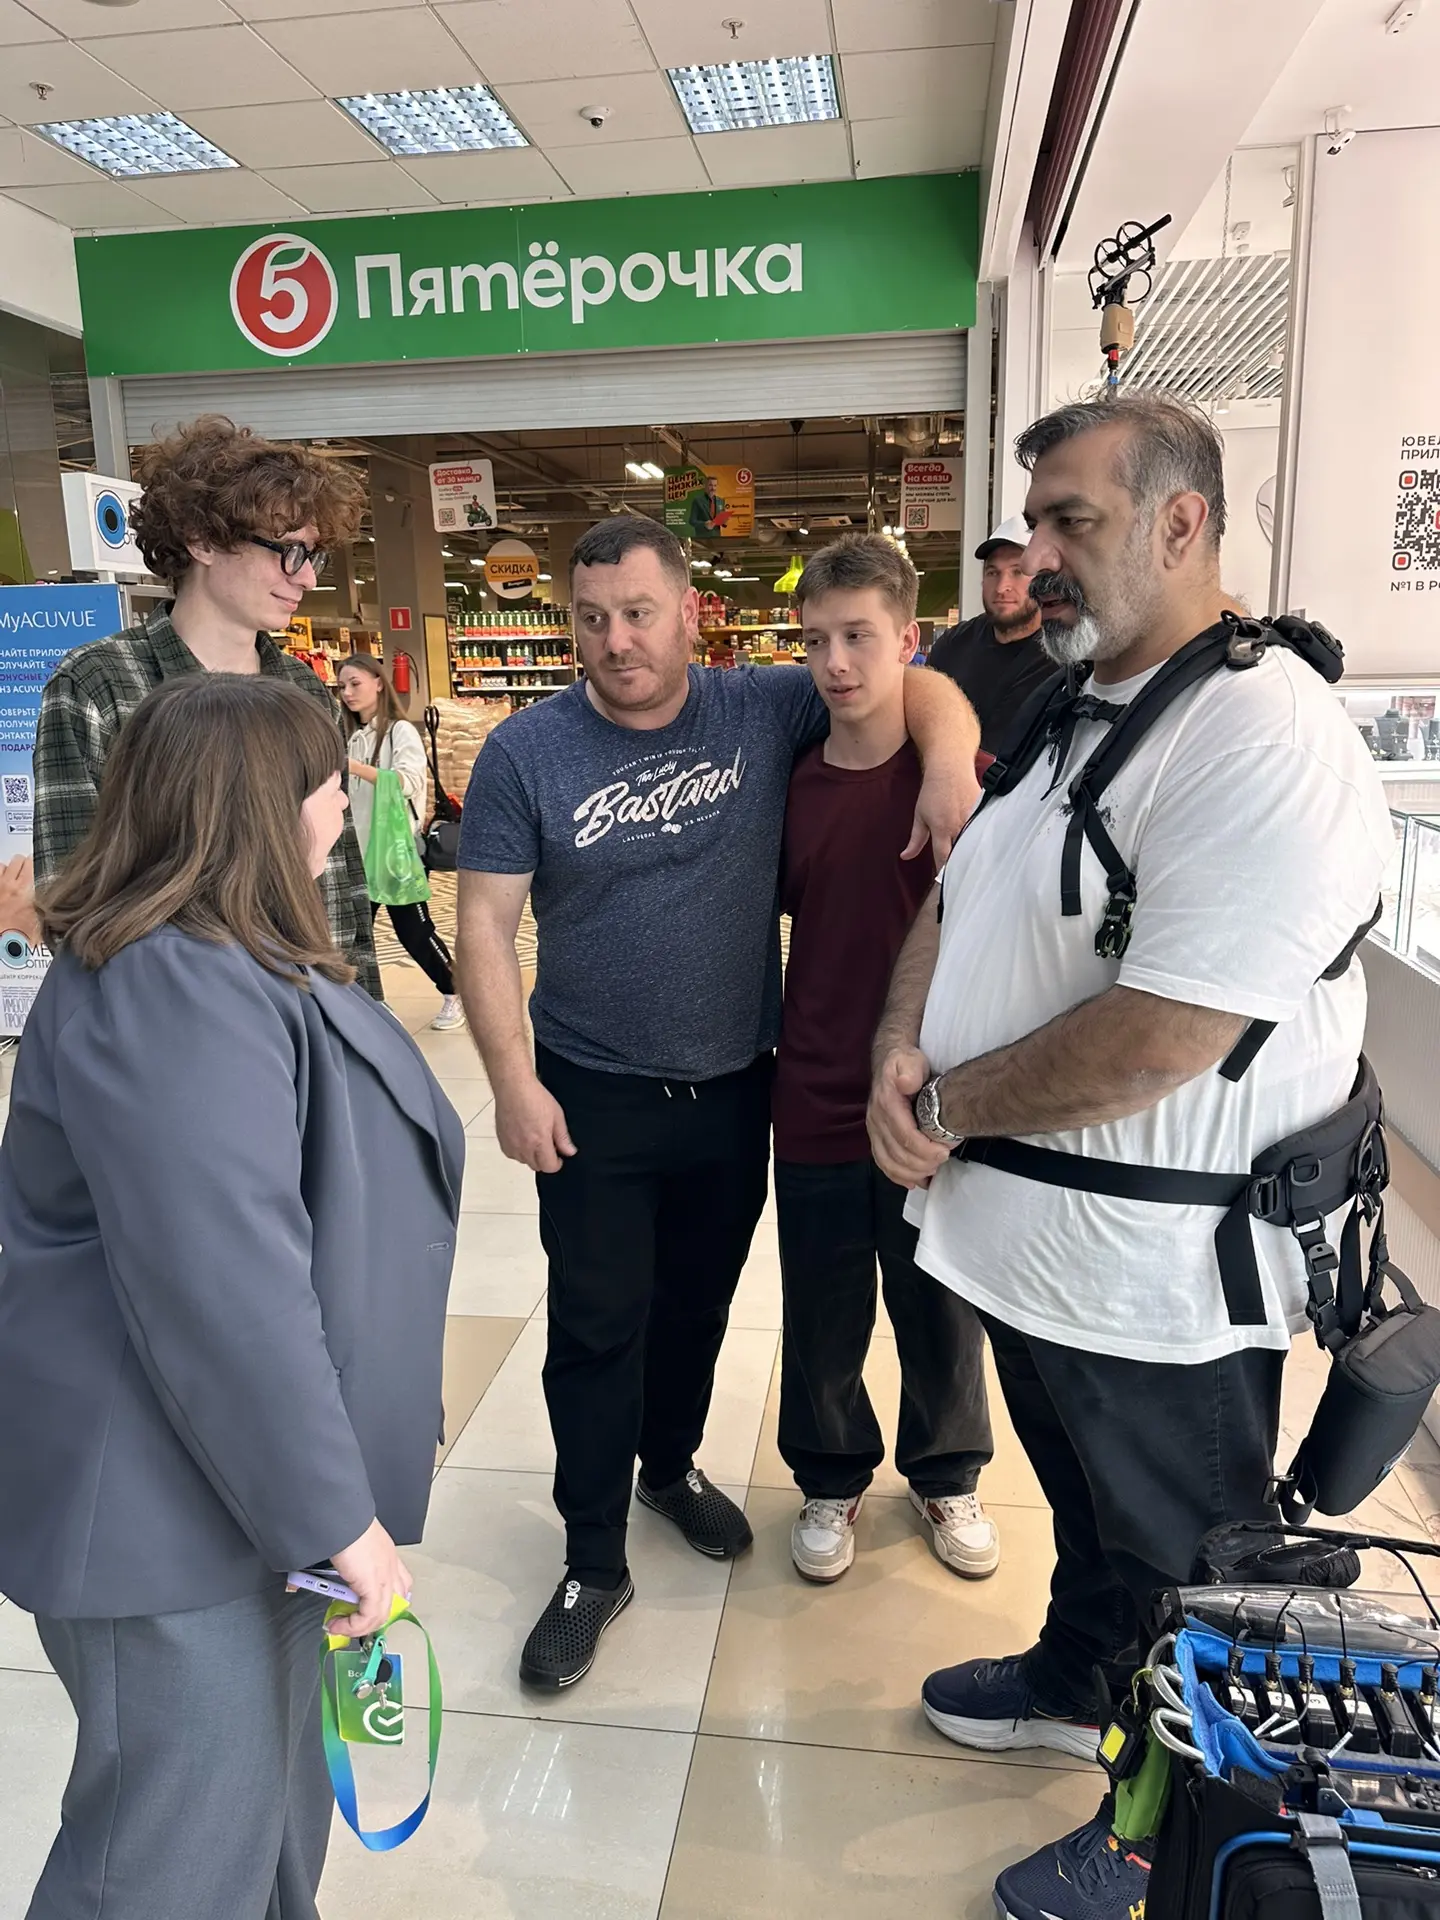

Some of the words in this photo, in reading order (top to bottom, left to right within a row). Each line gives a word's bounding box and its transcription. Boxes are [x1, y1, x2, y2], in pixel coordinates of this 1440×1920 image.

[354, 240, 803, 325] Пятёрочка
[437, 468, 471, 477] Доставка
[907, 464, 941, 473] Всегда
[668, 471, 697, 485] ЦЕНТР
[922, 474, 949, 482] связи
[668, 478, 704, 493] НИЗКИХ
[668, 490, 686, 500] ЦЕН
[490, 564, 534, 574] СКИДКА
[1416, 581, 1424, 591] В
[1429, 580, 1440, 591] Р
[636, 769, 653, 787] The
[652, 761, 677, 782] Lucky
[573, 746, 747, 849] Bastard
